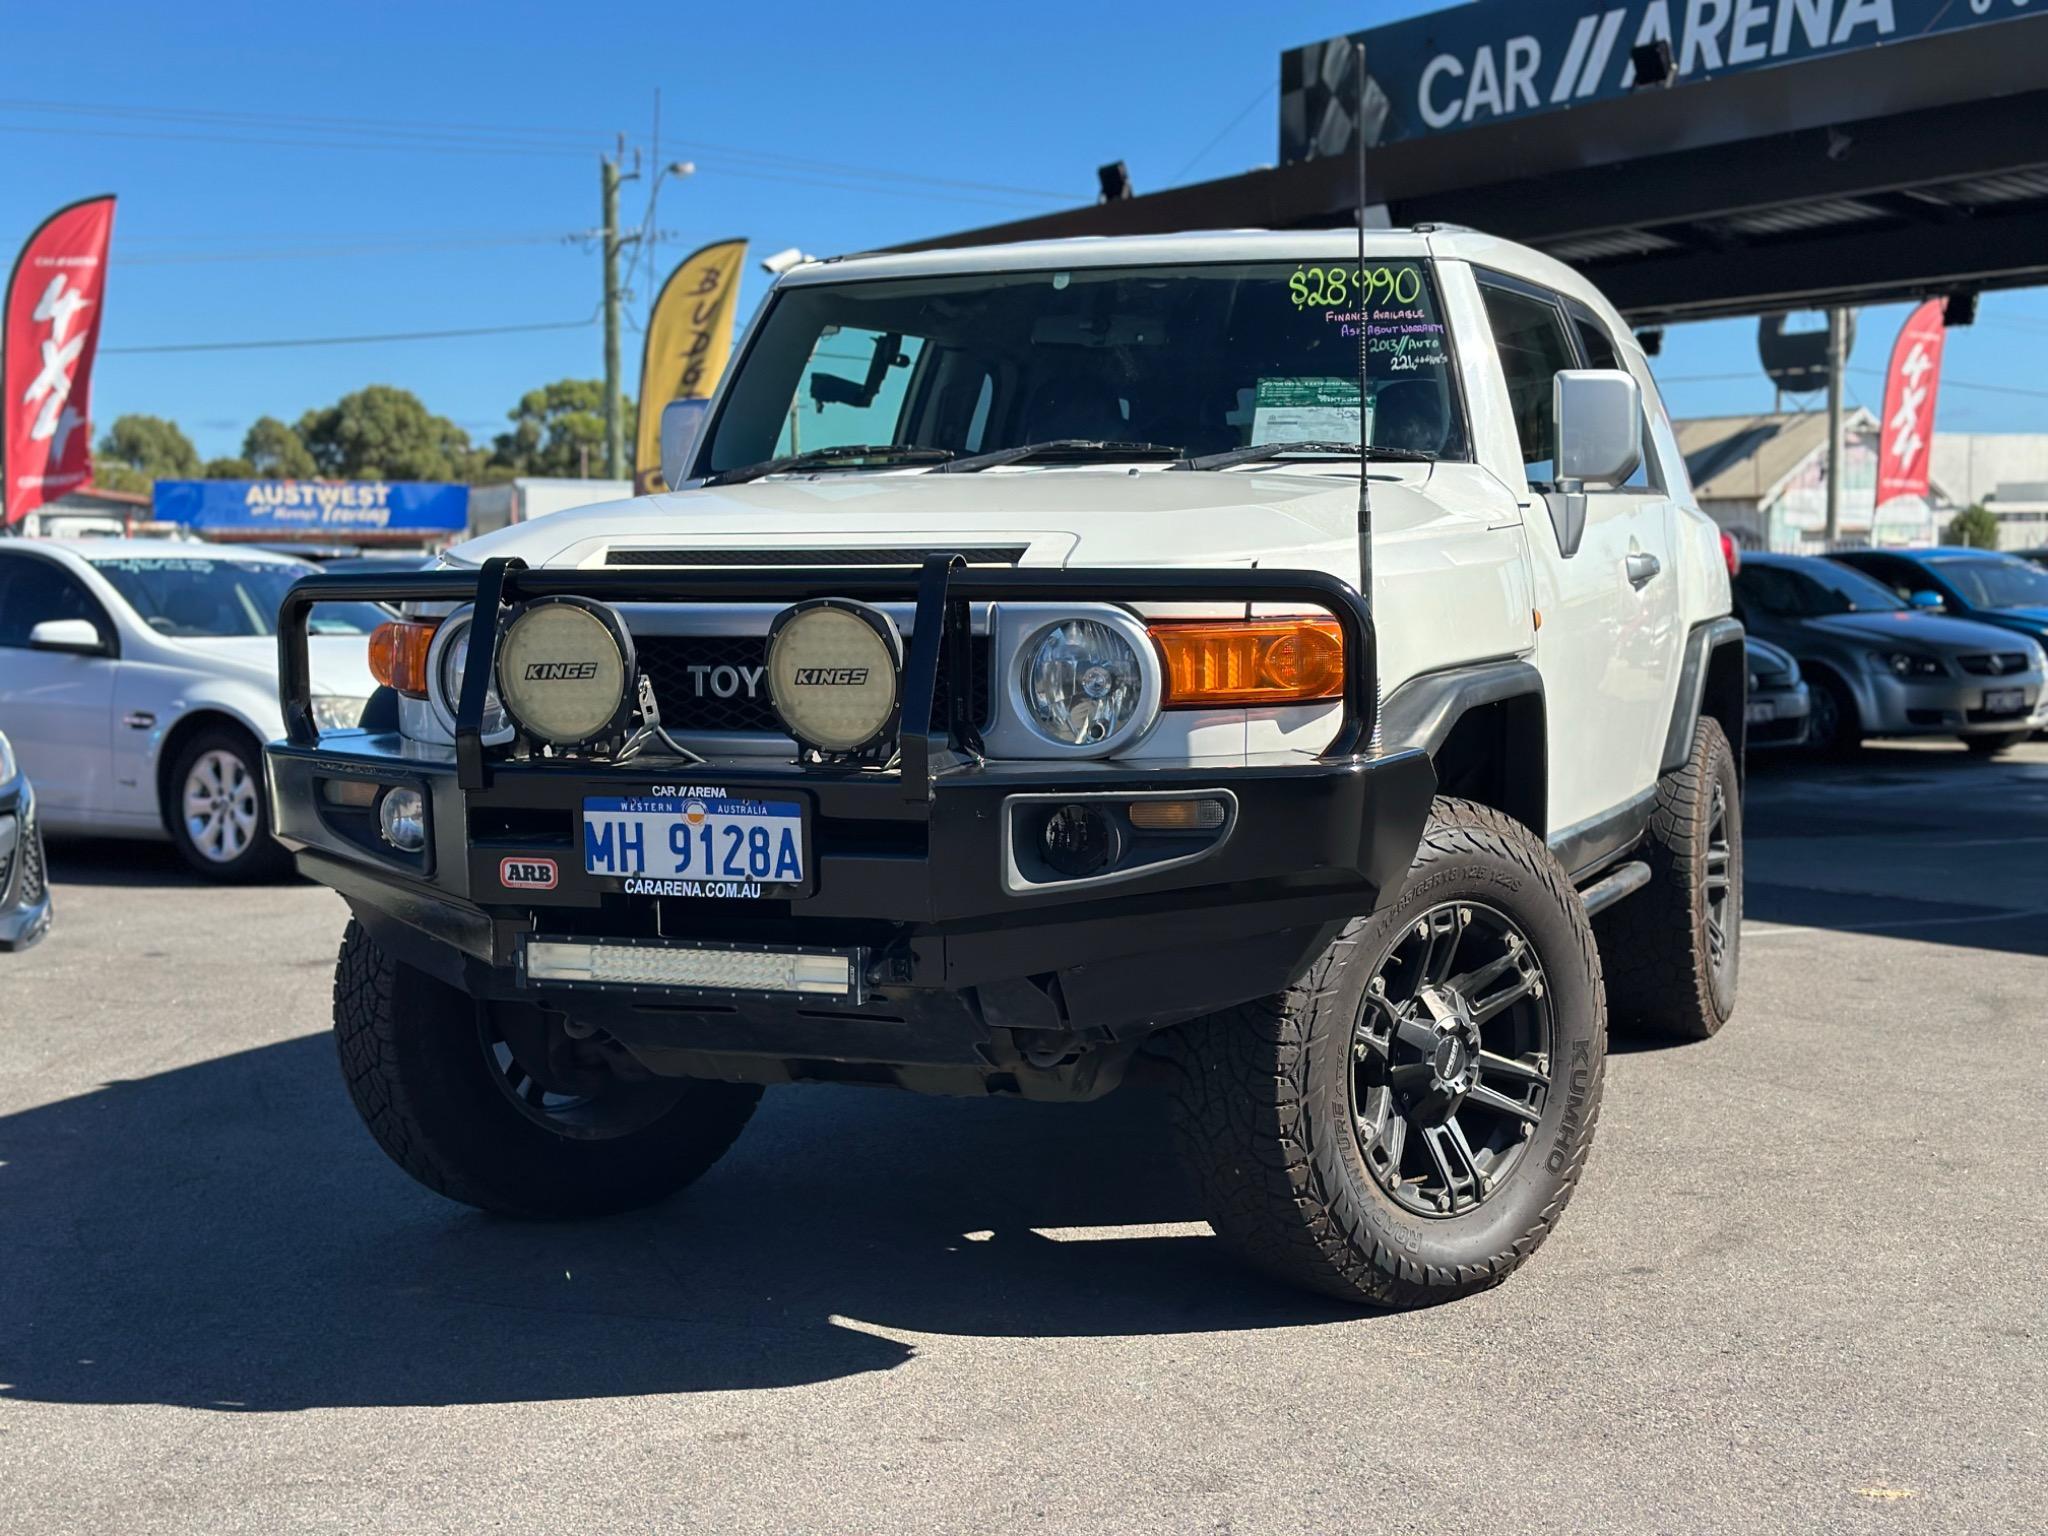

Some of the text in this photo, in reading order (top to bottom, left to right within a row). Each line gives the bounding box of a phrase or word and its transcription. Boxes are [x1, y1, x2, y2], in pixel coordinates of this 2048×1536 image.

[1418, 36, 1541, 129] CAR
[1289, 264, 1421, 312] $28,990
[245, 482, 391, 506] AUSTWEST
[525, 663, 597, 679] KINGS
[795, 668, 868, 685] KINGS
[652, 785, 676, 797] CAR
[687, 786, 727, 798] ARENA
[621, 801, 768, 816] WESTERN AUSTRALIA
[585, 822, 802, 880] MH 9128A
[507, 863, 552, 882] ARB
[624, 878, 761, 899] CARARENA.COM.AU
[1544, 1039, 1590, 1175] KUMHO
